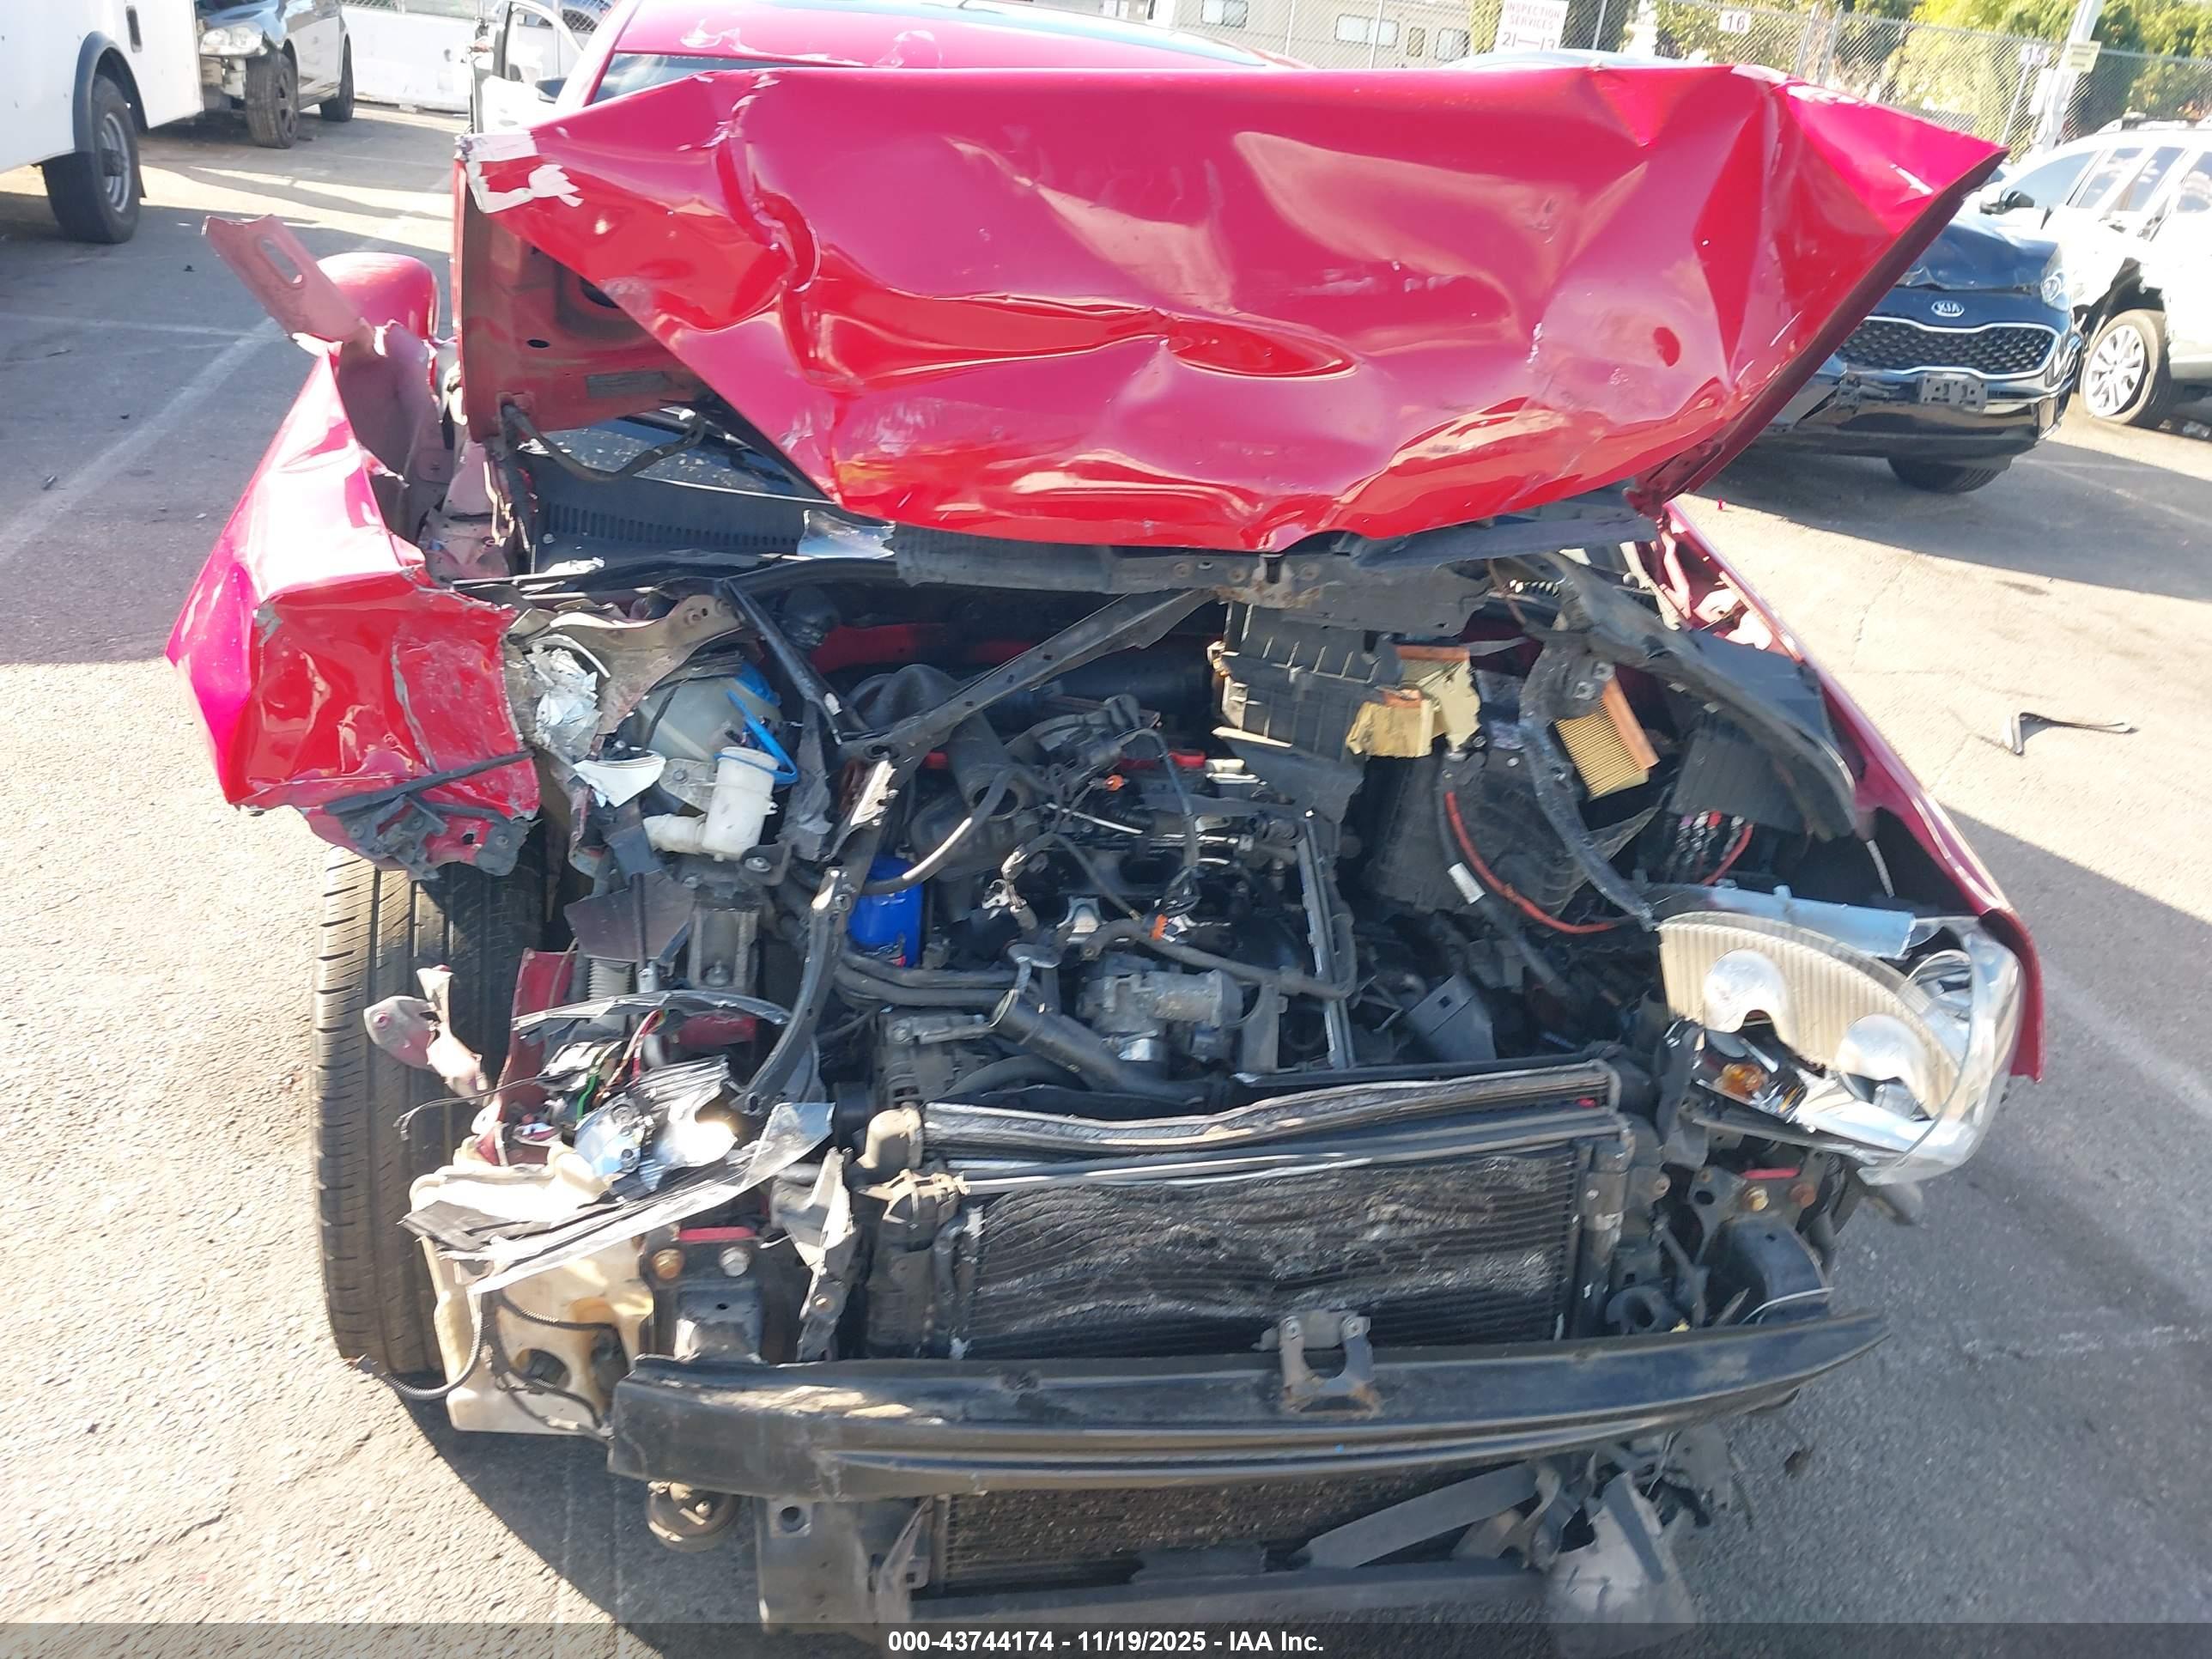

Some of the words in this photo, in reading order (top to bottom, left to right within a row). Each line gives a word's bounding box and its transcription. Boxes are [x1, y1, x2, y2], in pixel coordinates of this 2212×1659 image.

[1505, 2, 1561, 19] INSPECTION
[1510, 13, 1554, 30] SERVICES
[1727, 13, 1746, 31] 16
[1935, 301, 1961, 314] KIA
